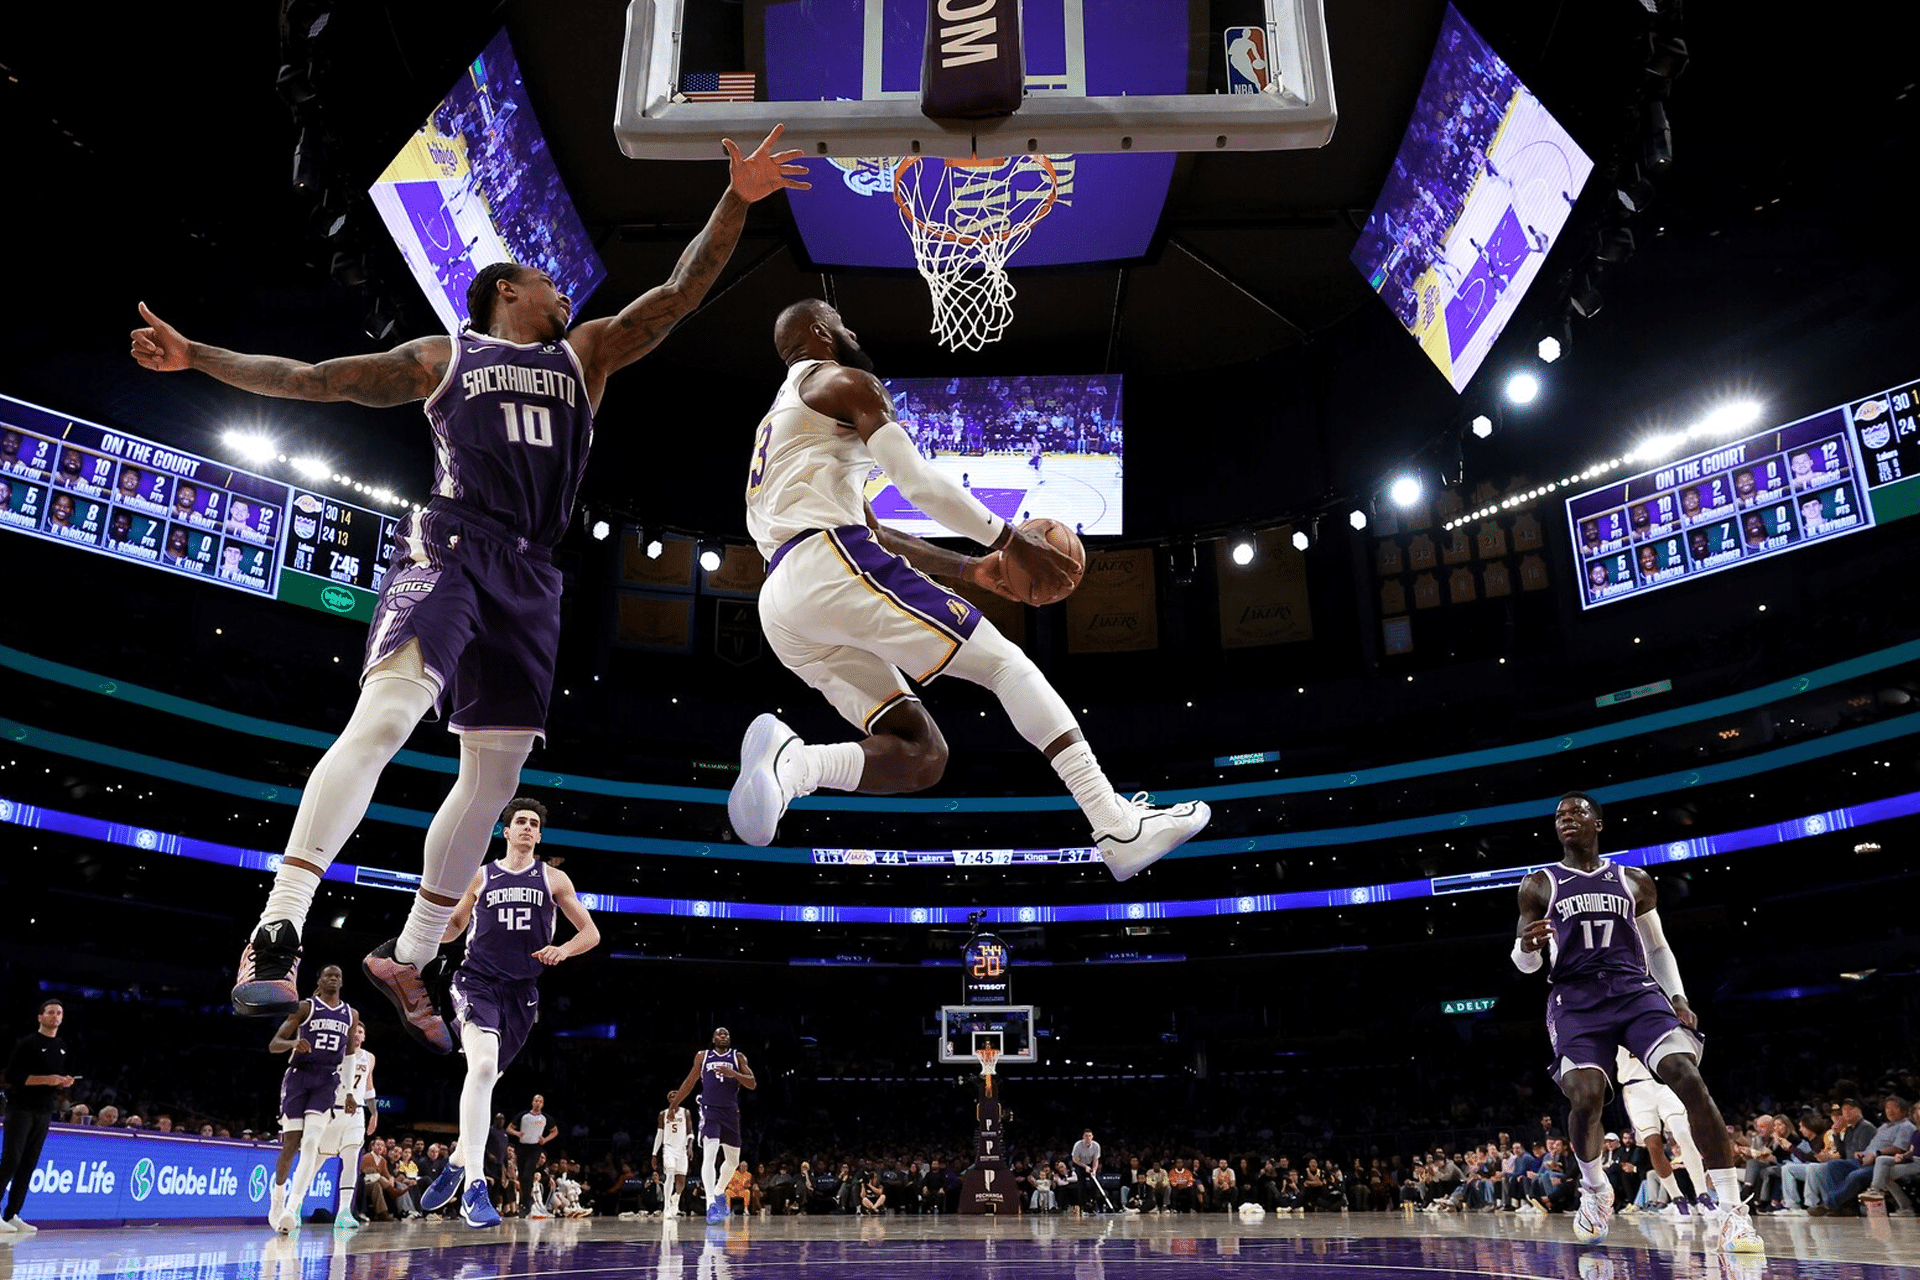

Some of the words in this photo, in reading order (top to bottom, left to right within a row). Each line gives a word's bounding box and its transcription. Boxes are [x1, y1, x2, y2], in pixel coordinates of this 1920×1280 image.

[1234, 84, 1254, 95] NBA
[462, 364, 576, 408] SACRAMENTO
[1892, 392, 1910, 412] 30
[500, 402, 554, 447] 10
[1898, 415, 1916, 435] 24
[36, 441, 48, 457] 3
[100, 433, 125, 455] ON
[125, 440, 153, 464] THE
[152, 449, 200, 478] COURT
[1821, 441, 1838, 460] 12
[31, 457, 47, 469] PTS
[94, 458, 111, 476] 10
[1655, 469, 1675, 491] ON
[1676, 460, 1700, 483] THE
[1701, 445, 1746, 475] COURT
[1766, 461, 1777, 478] 0
[92, 474, 107, 486] PTS
[153, 476, 165, 492] 2
[1712, 479, 1721, 496] 2
[25, 486, 39, 504] 5
[149, 491, 164, 503] PTS
[208, 492, 219, 508] 0
[1834, 487, 1845, 504] 4
[21, 503, 37, 515] PTS
[87, 504, 99, 520] 8
[205, 507, 219, 519] PTS
[1657, 496, 1672, 513] 10
[259, 507, 274, 524] 12
[325, 504, 338, 521] 30
[340, 509, 352, 525] 14
[1610, 513, 1619, 529] 3
[1776, 505, 1786, 523] 0
[82, 520, 98, 532] PTS
[146, 520, 157, 536] 7
[257, 523, 270, 535] PTS
[1721, 523, 1729, 540] 7
[141, 535, 156, 547] PTS
[200, 535, 212, 552] 0
[322, 526, 335, 543] 24
[337, 530, 349, 546] 13
[1668, 539, 1677, 556] 8
[197, 551, 211, 562] PTS
[253, 551, 265, 567] 4
[329, 551, 360, 577] 7:45
[1617, 554, 1626, 571] 5
[250, 565, 263, 577] PTS
[387, 581, 435, 596] KINGS
[881, 852, 899, 863] 44
[917, 853, 944, 862] Lakers
[960, 851, 994, 864] 7:45
[1003, 855, 1009, 863] 2
[1068, 850, 1085, 862] 37
[486, 887, 544, 908] SACRAMENTO
[1554, 893, 1630, 922] SACRAMENTO
[498, 908, 531, 930] 42
[1580, 920, 1614, 949] 17
[977, 945, 1002, 956] 7:44
[973, 956, 1000, 976] 20
[314, 1033, 340, 1051] 23
[76, 1160, 115, 1194] Life
[157, 1165, 207, 1196] Globe
[209, 1167, 238, 1196] Life
[308, 1171, 332, 1198] Life
